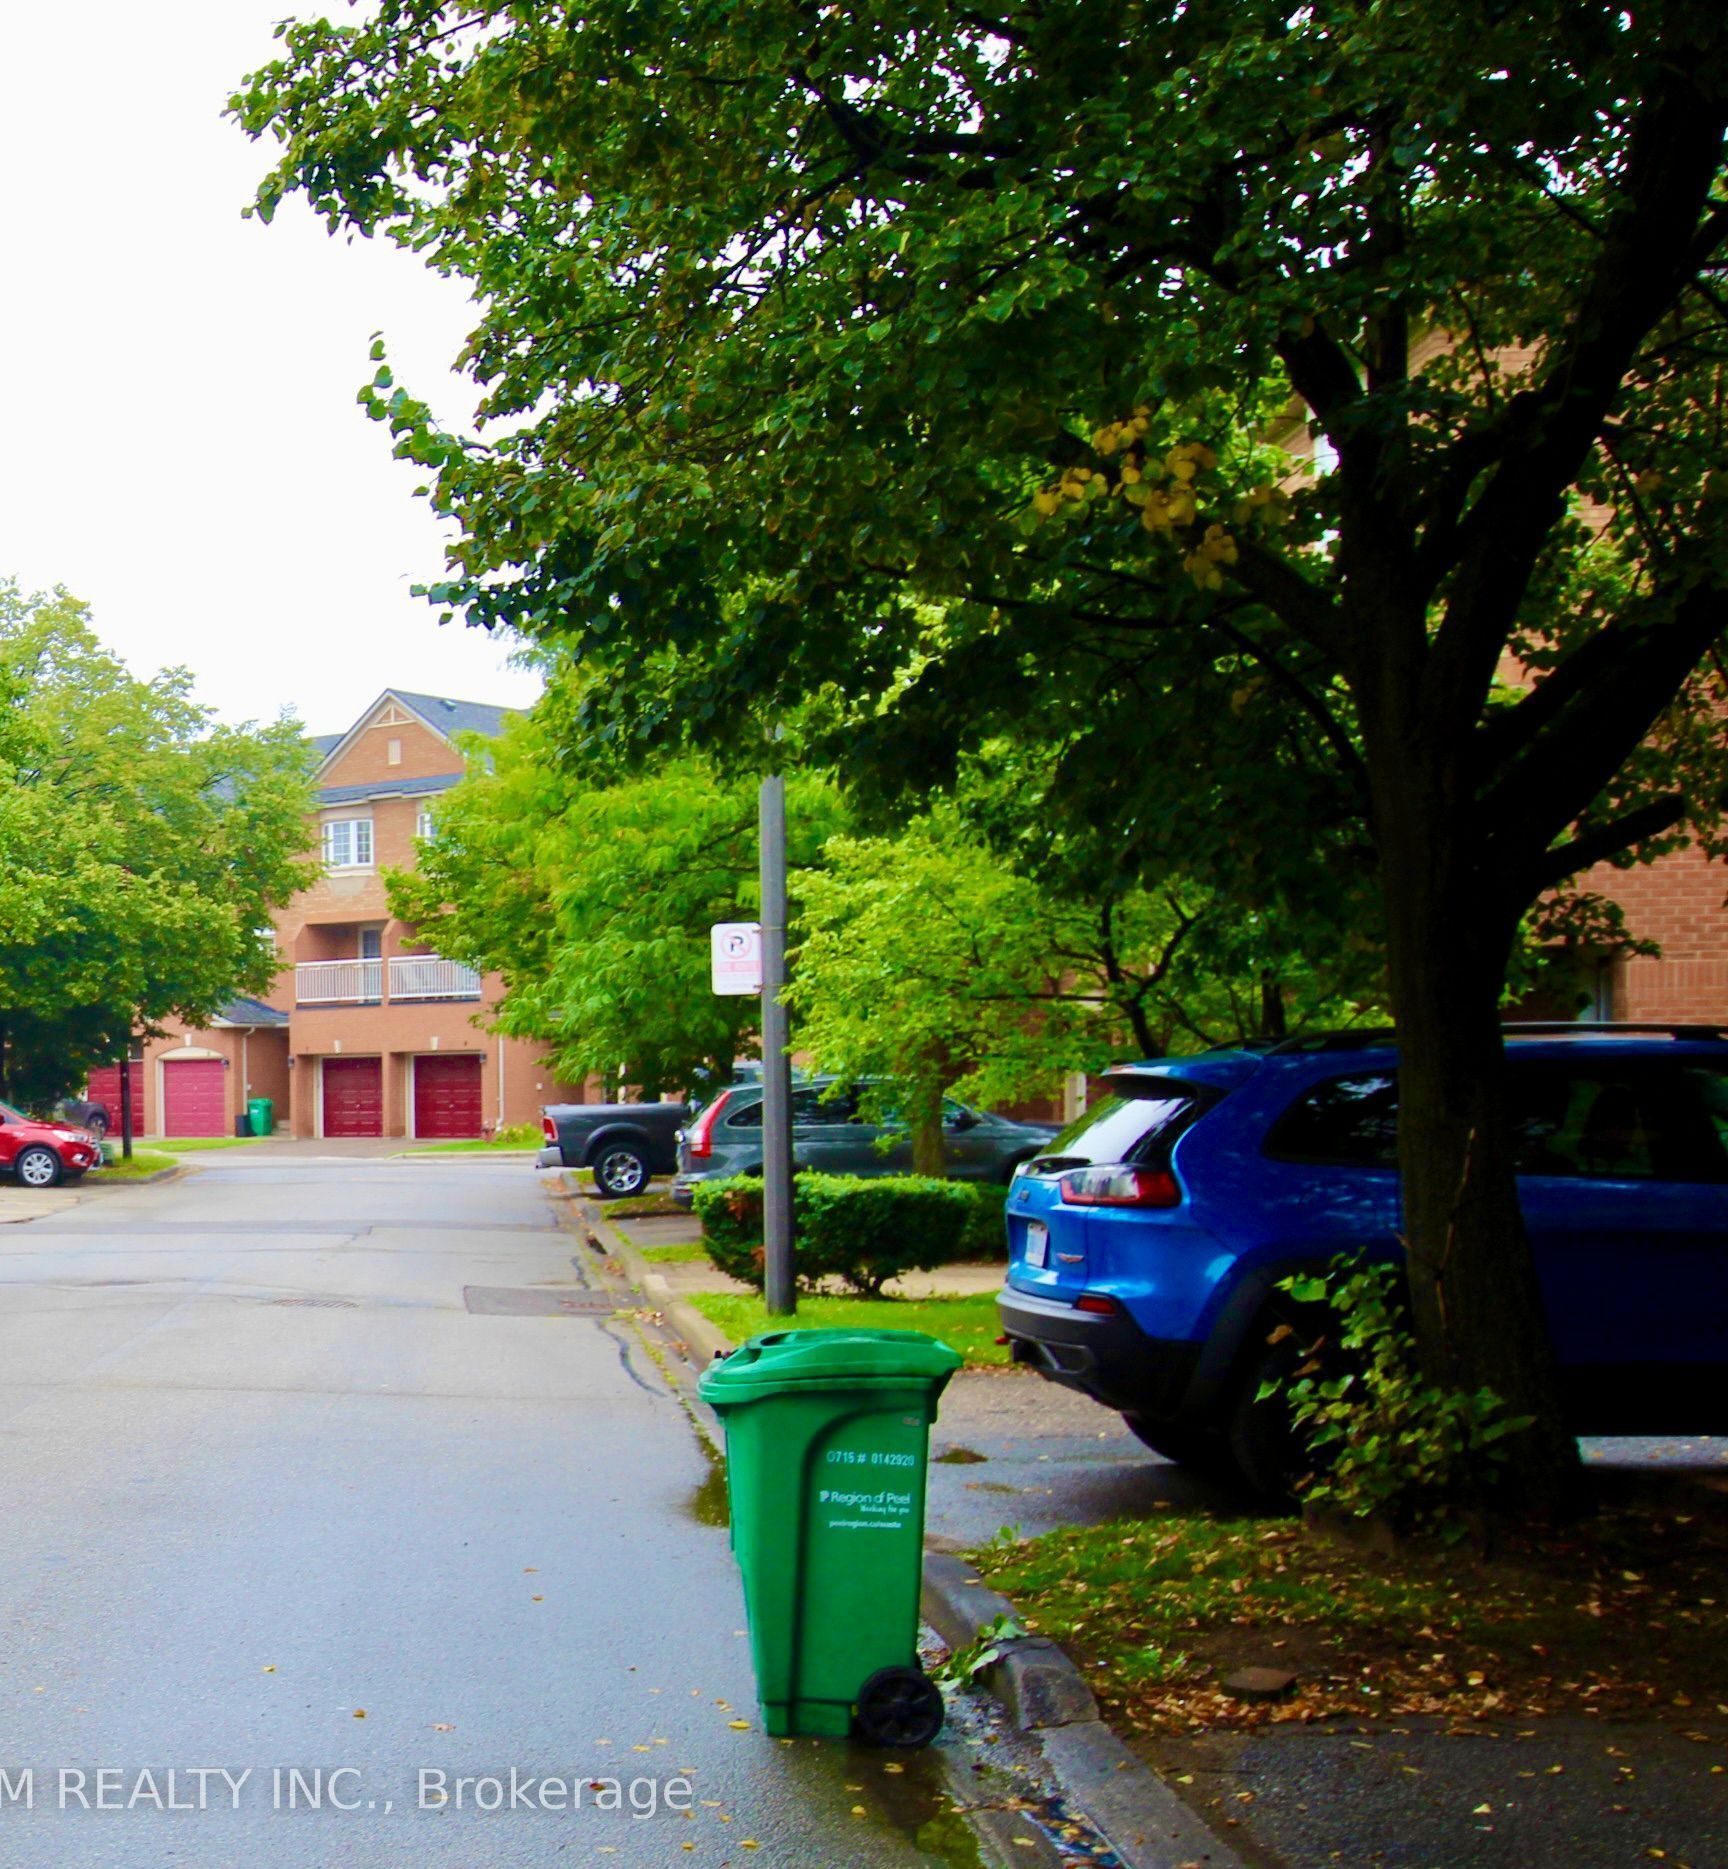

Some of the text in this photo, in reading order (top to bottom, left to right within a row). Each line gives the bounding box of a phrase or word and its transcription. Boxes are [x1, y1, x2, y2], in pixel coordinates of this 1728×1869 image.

[831, 1491, 872, 1506] Region
[874, 1491, 885, 1504] of
[887, 1492, 911, 1504] Peel
